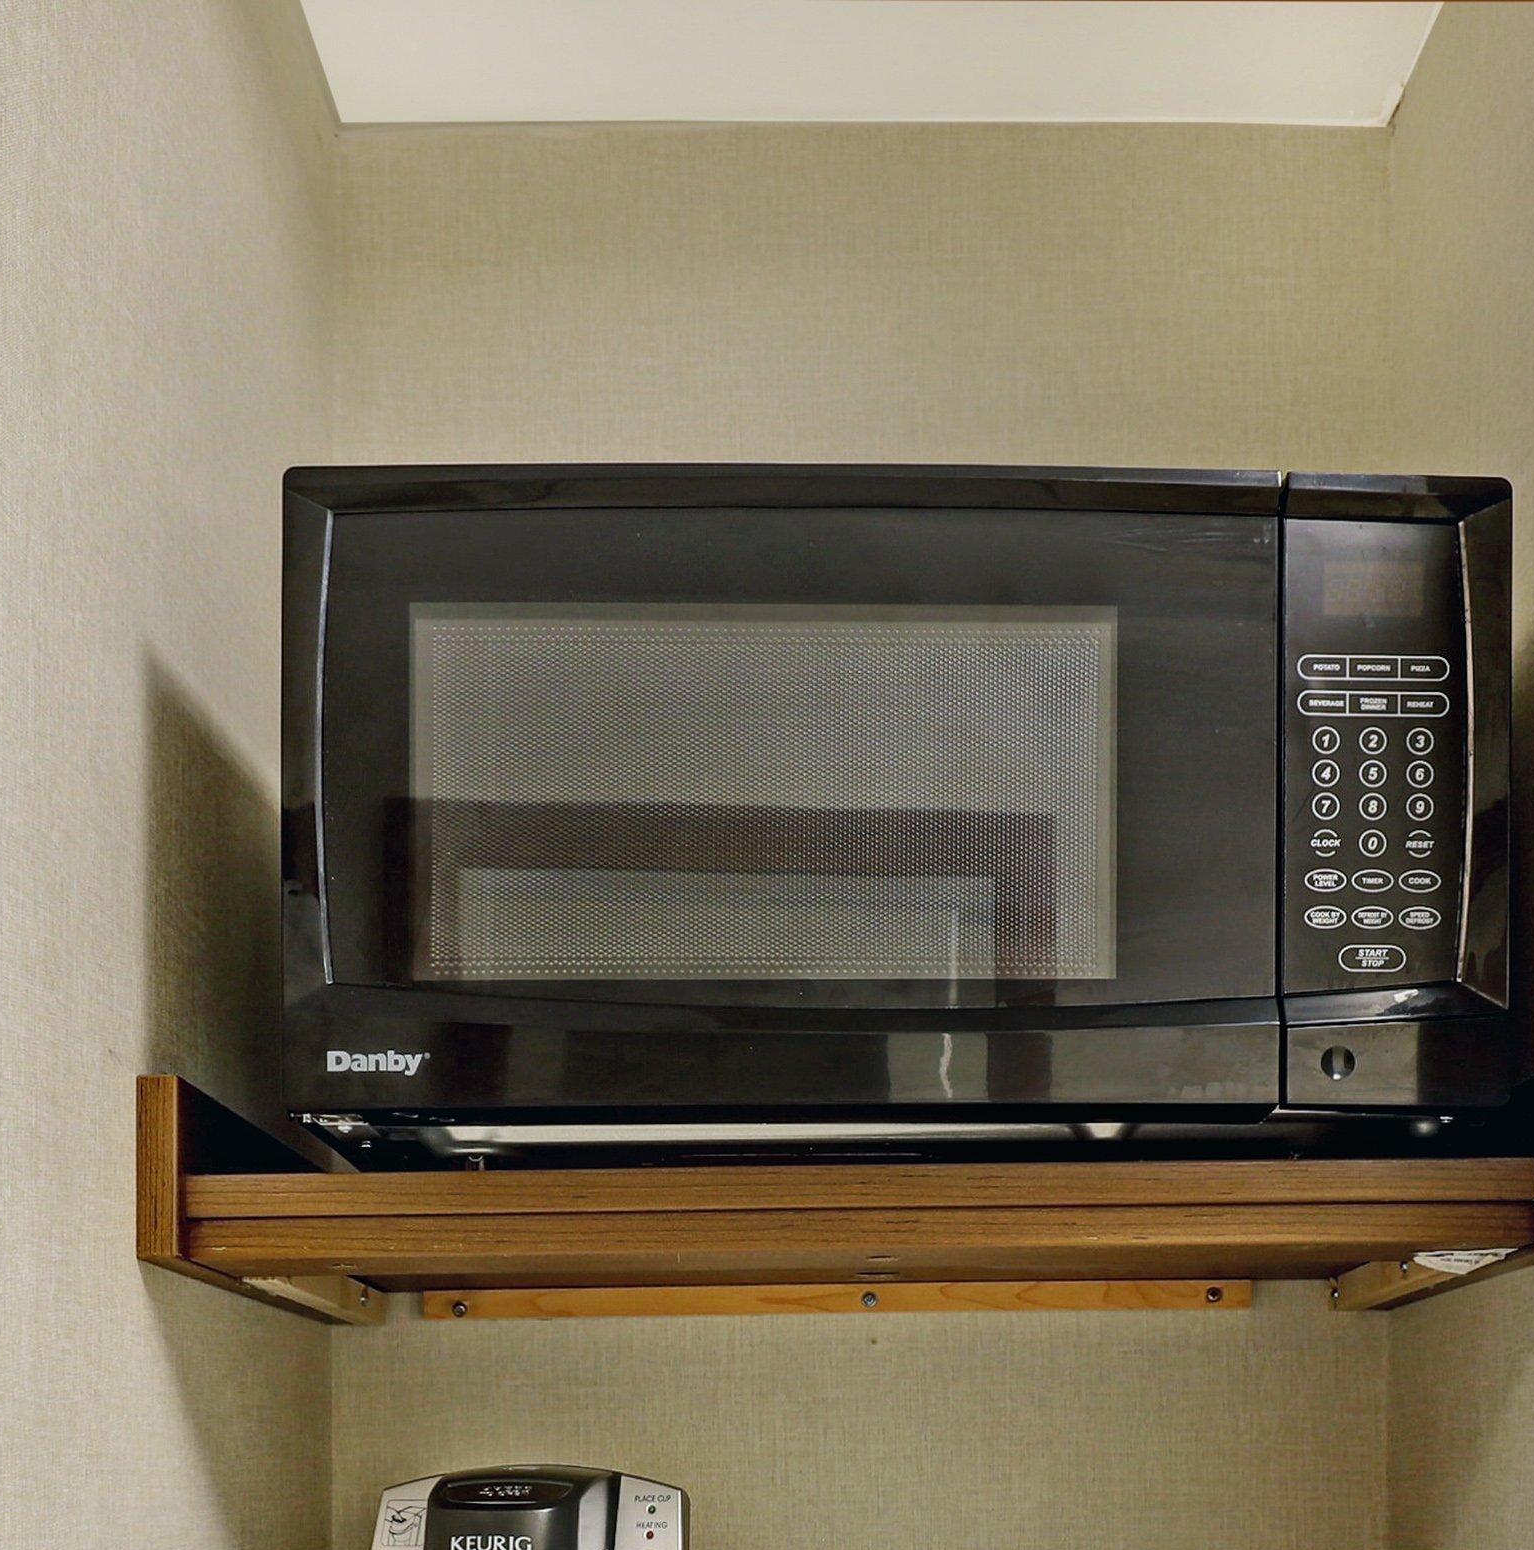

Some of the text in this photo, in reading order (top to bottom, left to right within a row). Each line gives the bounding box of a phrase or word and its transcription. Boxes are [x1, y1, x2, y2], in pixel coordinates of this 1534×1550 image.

[1312, 663, 1341, 671] POTATO
[1356, 664, 1391, 672] POPCORN
[1308, 699, 1345, 707] BEVERAGE
[1321, 734, 1330, 748] 1
[1368, 734, 1378, 748] 2
[1415, 735, 1425, 748] 3
[1320, 766, 1332, 781] 4
[1368, 767, 1378, 781] 5
[1415, 768, 1425, 781] 6
[1321, 800, 1331, 814] 7
[1367, 800, 1378, 814] 8
[1415, 800, 1425, 814] 9
[1310, 839, 1342, 848] CLOCK
[1367, 836, 1378, 851] 0
[1405, 840, 1435, 849] RESET
[1314, 880, 1337, 888] LEVEL
[1361, 877, 1384, 885] TIMER
[1408, 877, 1432, 885] COOK
[1310, 911, 1341, 919] COOK BY
[1312, 917, 1338, 925] WEIGHT
[1405, 917, 1434, 925] DEFROST
[1358, 949, 1389, 957] START
[1361, 959, 1385, 968] STOP
[327, 1050, 423, 1076] Danby
[634, 1494, 672, 1503] PLACE CUP
[636, 1521, 668, 1529] HEATING
